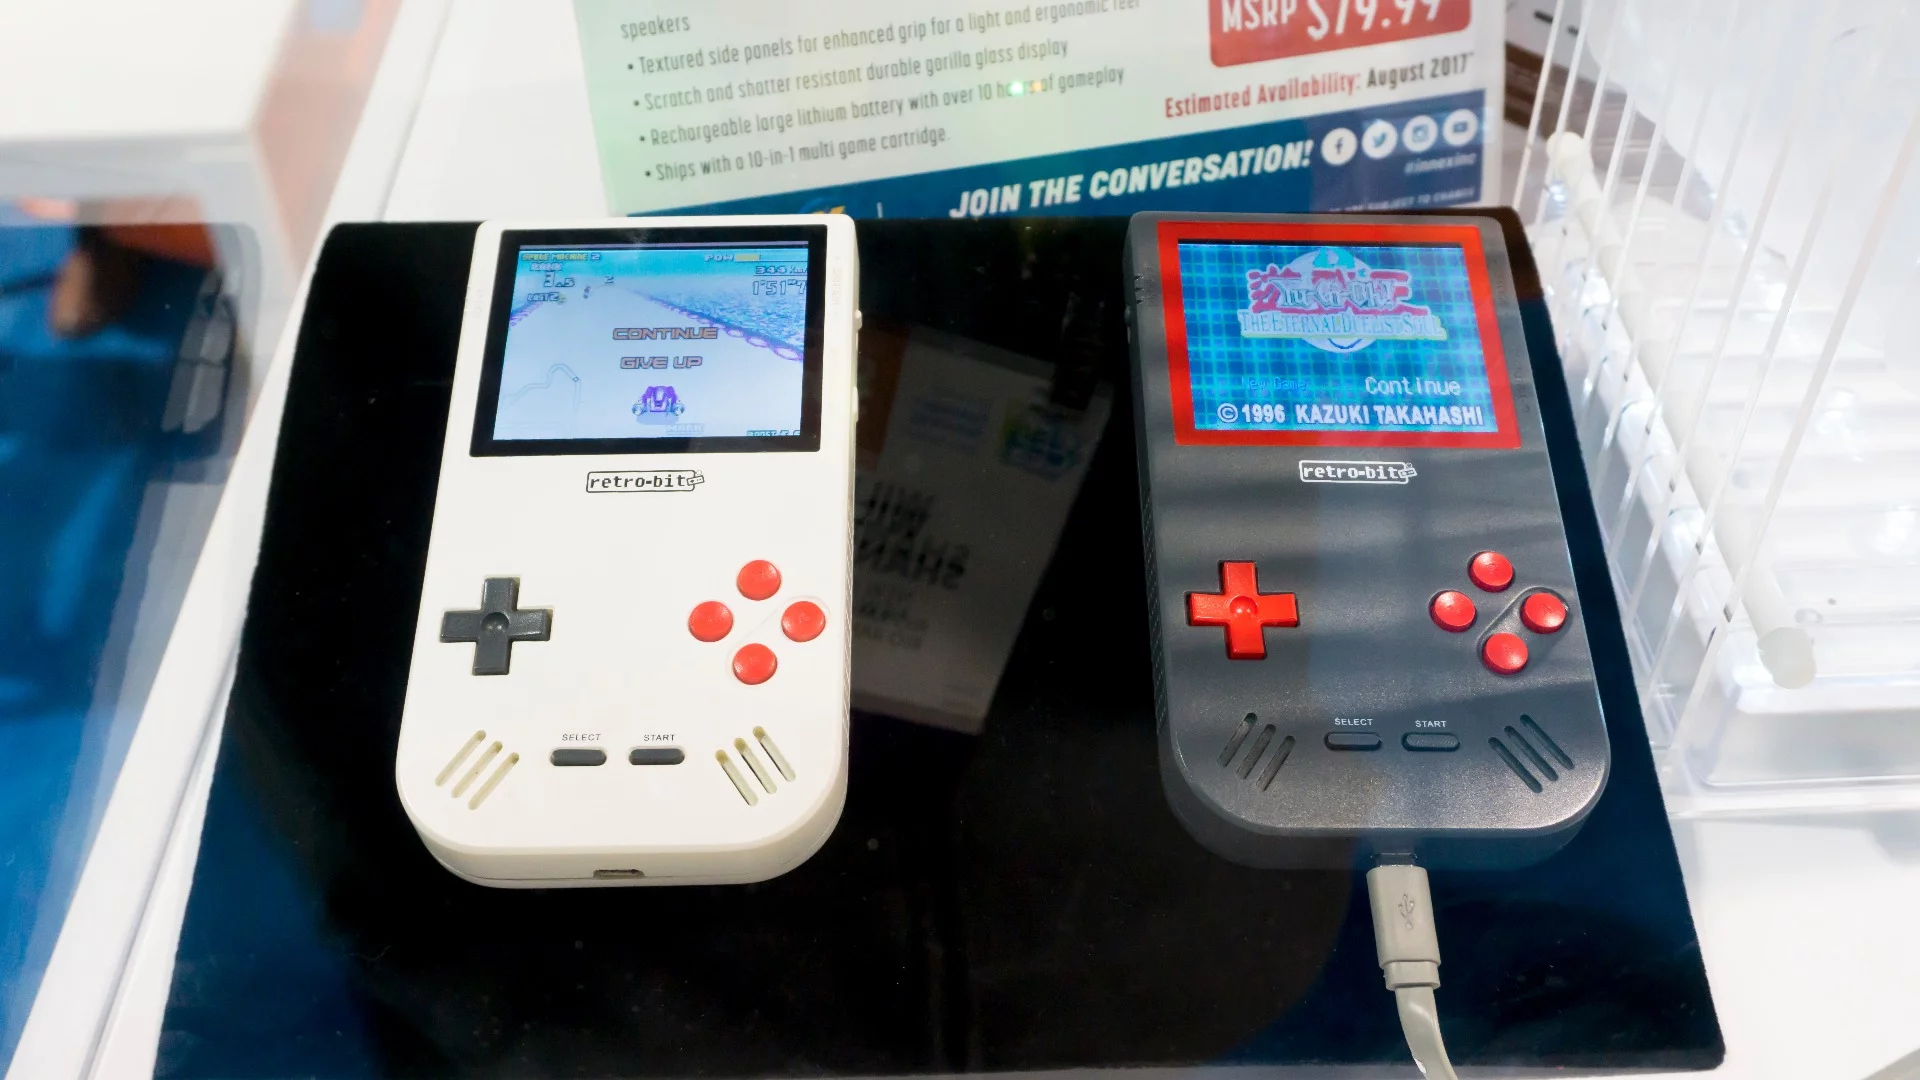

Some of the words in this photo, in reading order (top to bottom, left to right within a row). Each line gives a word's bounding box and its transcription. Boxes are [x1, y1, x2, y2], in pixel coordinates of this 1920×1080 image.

[1221, 0, 1297, 33] MSRP
[620, 16, 691, 41] speakers
[638, 48, 704, 75] Textured
[708, 46, 740, 66] side
[744, 37, 794, 64] panels
[797, 35, 818, 53] for
[823, 23, 895, 50] enhanced
[899, 21, 927, 44] grip
[931, 17, 951, 35] for
[956, 17, 965, 32] a
[968, 12, 1001, 33] light
[1005, 5, 1031, 26] and
[1035, 0, 1108, 23] ergonomic
[644, 86, 702, 111] Scratch
[706, 82, 734, 104] and
[738, 77, 791, 99] shatter
[795, 67, 862, 91] resistant
[866, 57, 921, 81] durable
[925, 50, 972, 77] gorilla
[975, 47, 1014, 70] glass
[1018, 37, 1069, 61] display
[1165, 84, 1251, 118] Estimated
[1256, 71, 1361, 106] Availability:
[1366, 61, 1425, 90] August
[650, 115, 751, 146] Rechargeable
[755, 112, 794, 135] large
[797, 105, 848, 127] lithium
[851, 97, 903, 120] battery
[908, 90, 939, 111] with
[942, 87, 973, 106] over
[978, 82, 993, 101] 10
[1040, 73, 1055, 93] of
[1057, 66, 1126, 94] gameplay
[655, 161, 697, 182] Ships
[700, 153, 733, 176] with
[735, 156, 745, 171] a
[747, 146, 796, 169] 10-in-1
[799, 140, 835, 162] multi
[838, 138, 877, 160] game
[949, 183, 1022, 218] JOIN
[1028, 174, 1085, 208] THE
[1089, 139, 1315, 198] CONVERSATION!
[1241, 313, 1271, 332] THE
[613, 327, 718, 341] CONTINUE
[620, 356, 668, 369] GIVE
[673, 356, 703, 369] UP
[1364, 376, 1462, 396] Continue
[1295, 403, 1371, 425] KAZUKI
[1373, 404, 1484, 426] TAKAHASHI
[589, 473, 686, 489] retro-bit
[1302, 463, 1398, 481] retro-bit
[1334, 717, 1374, 726] SELECT
[1414, 719, 1447, 728] START
[561, 733, 602, 742] SELECT
[643, 734, 676, 742] START
